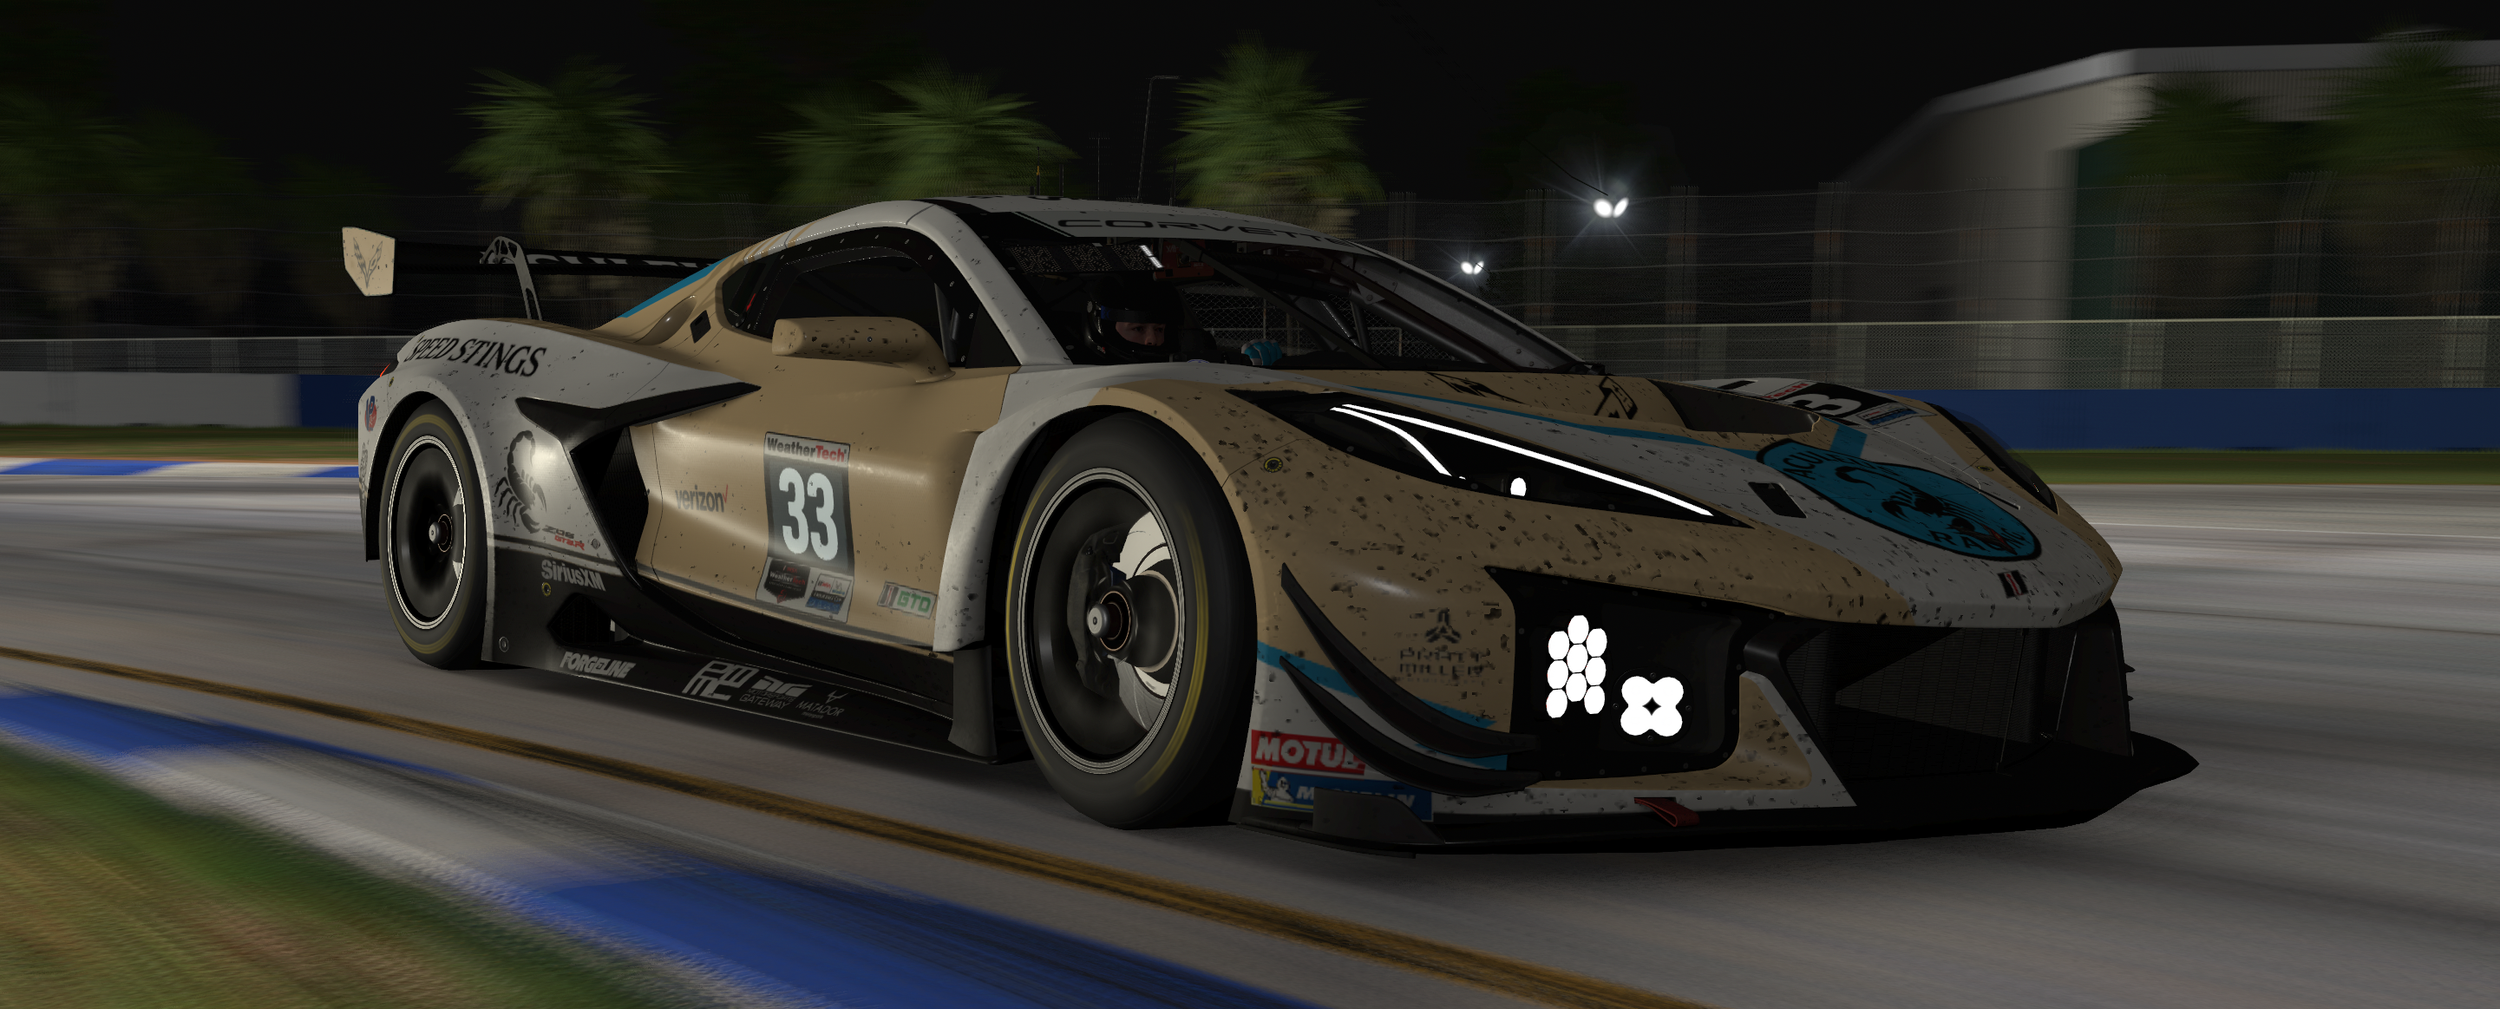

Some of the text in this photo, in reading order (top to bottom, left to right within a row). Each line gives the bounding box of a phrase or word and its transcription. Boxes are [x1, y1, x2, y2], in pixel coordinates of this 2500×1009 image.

[1057, 219, 1356, 248] CORVETTE
[403, 337, 547, 377] SPEED STINGS
[767, 437, 846, 462] WeatherTech
[675, 484, 725, 513] verizon
[779, 467, 839, 561] 33
[541, 559, 606, 592] SiriusXM
[897, 590, 931, 613] GTD
[560, 651, 637, 679] FORGELINE
[739, 694, 791, 710] GATEWAY
[795, 700, 846, 717] MATADOR
[1255, 735, 1360, 769] MOTUL
